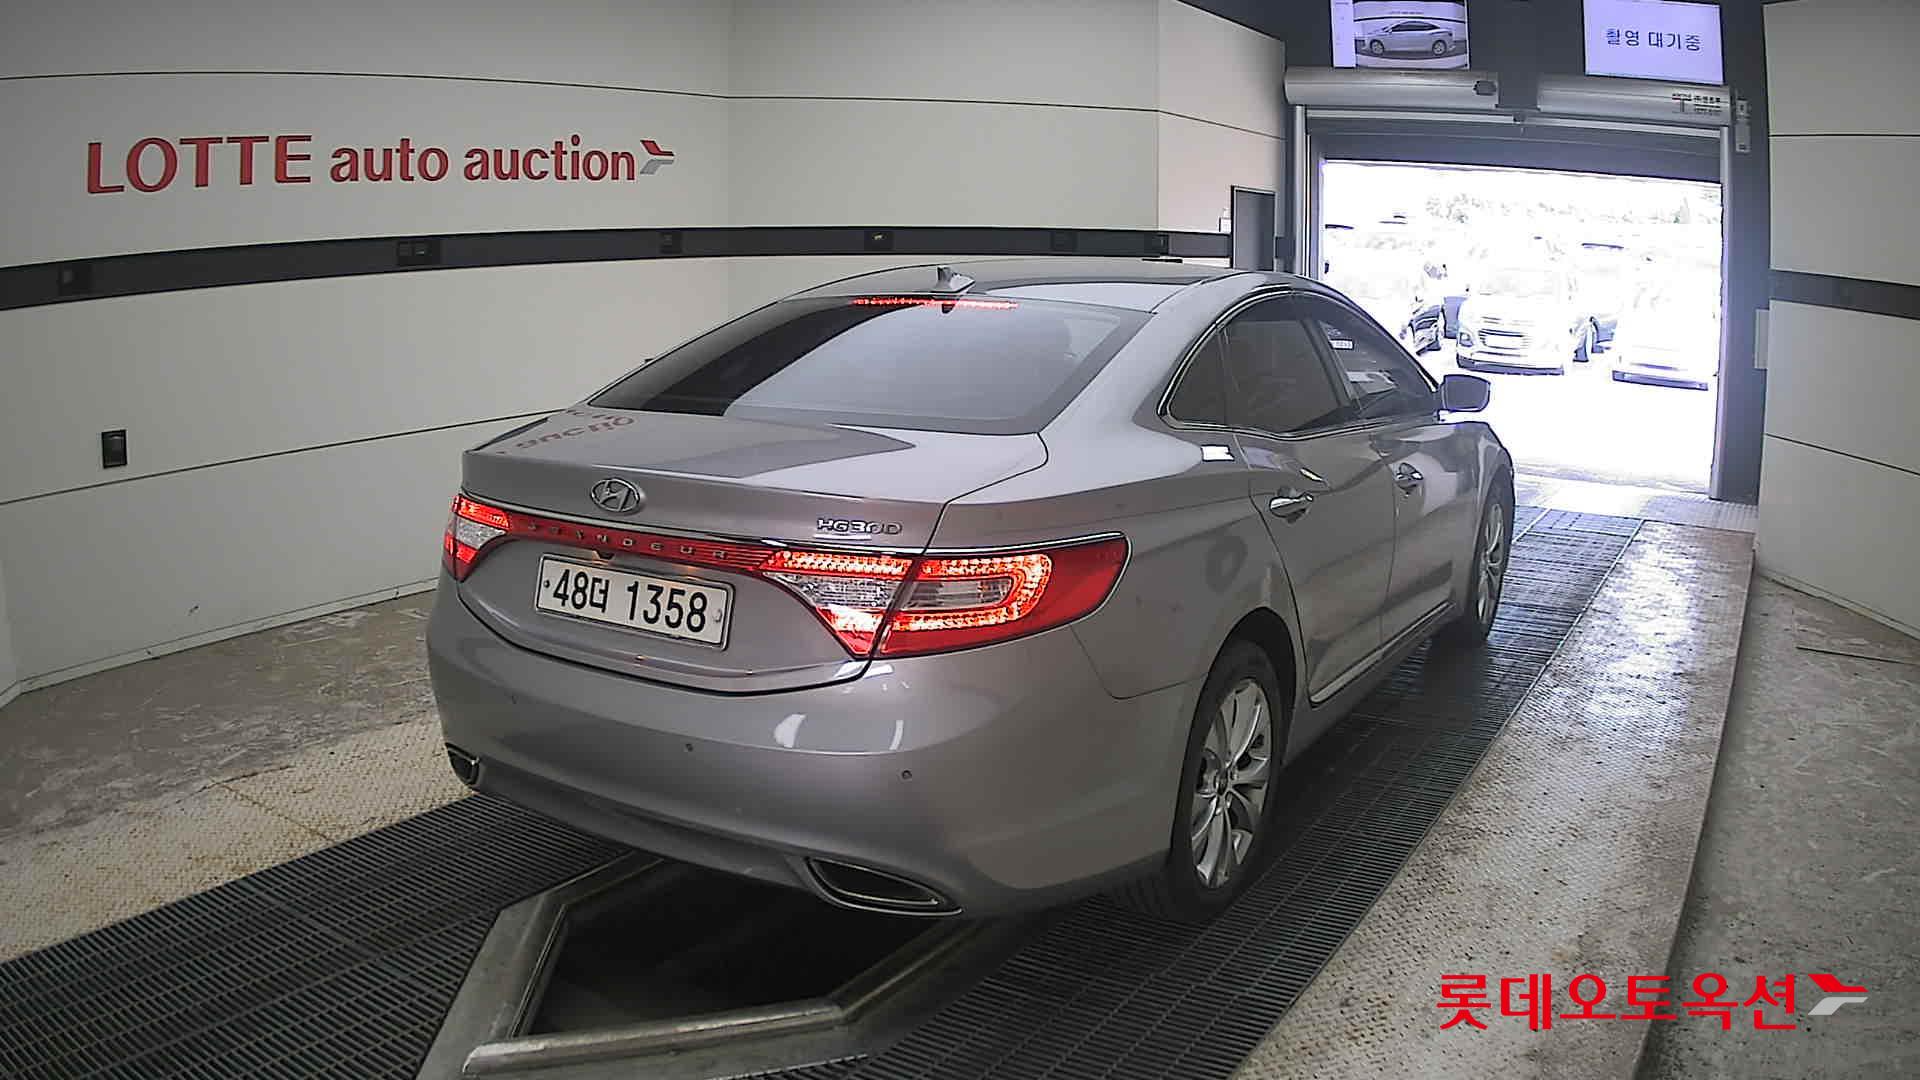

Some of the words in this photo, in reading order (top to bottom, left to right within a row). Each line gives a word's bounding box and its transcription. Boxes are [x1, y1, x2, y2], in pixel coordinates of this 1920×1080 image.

[1648, 32, 1701, 51] 대기중
[87, 134, 312, 194] LOTTE
[329, 137, 449, 182] auto
[463, 133, 635, 182] auction
[553, 568, 610, 613] 48더
[626, 580, 708, 633] 1358
